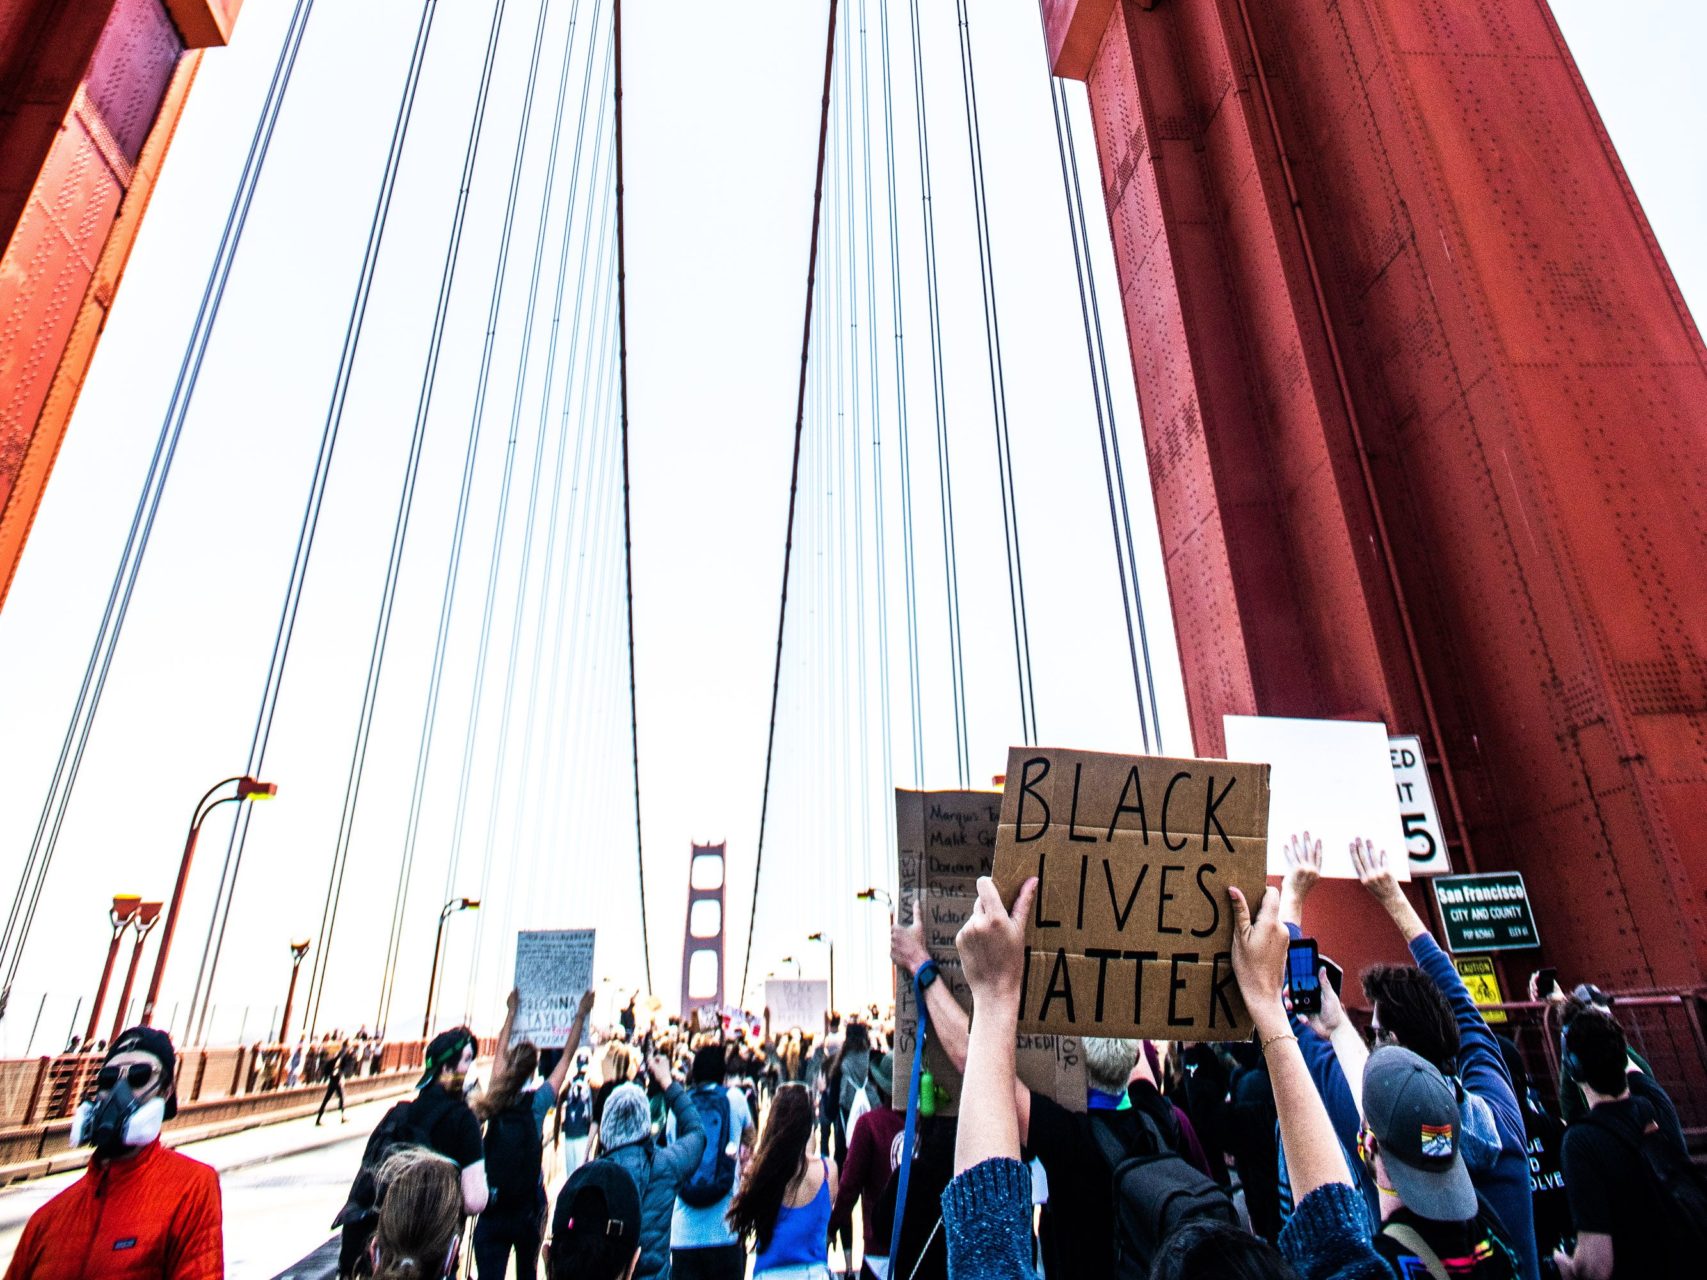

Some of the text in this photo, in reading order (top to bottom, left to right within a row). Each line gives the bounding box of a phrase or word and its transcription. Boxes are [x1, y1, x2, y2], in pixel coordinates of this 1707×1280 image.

[1015, 757, 1236, 853] BLACK
[1401, 813, 1436, 863] 5
[1035, 853, 1219, 938] LIVES
[1438, 883, 1524, 904] San Francisco
[1450, 904, 1522, 922] CITY AND COUNTY
[1017, 945, 1237, 1029] ATTER
